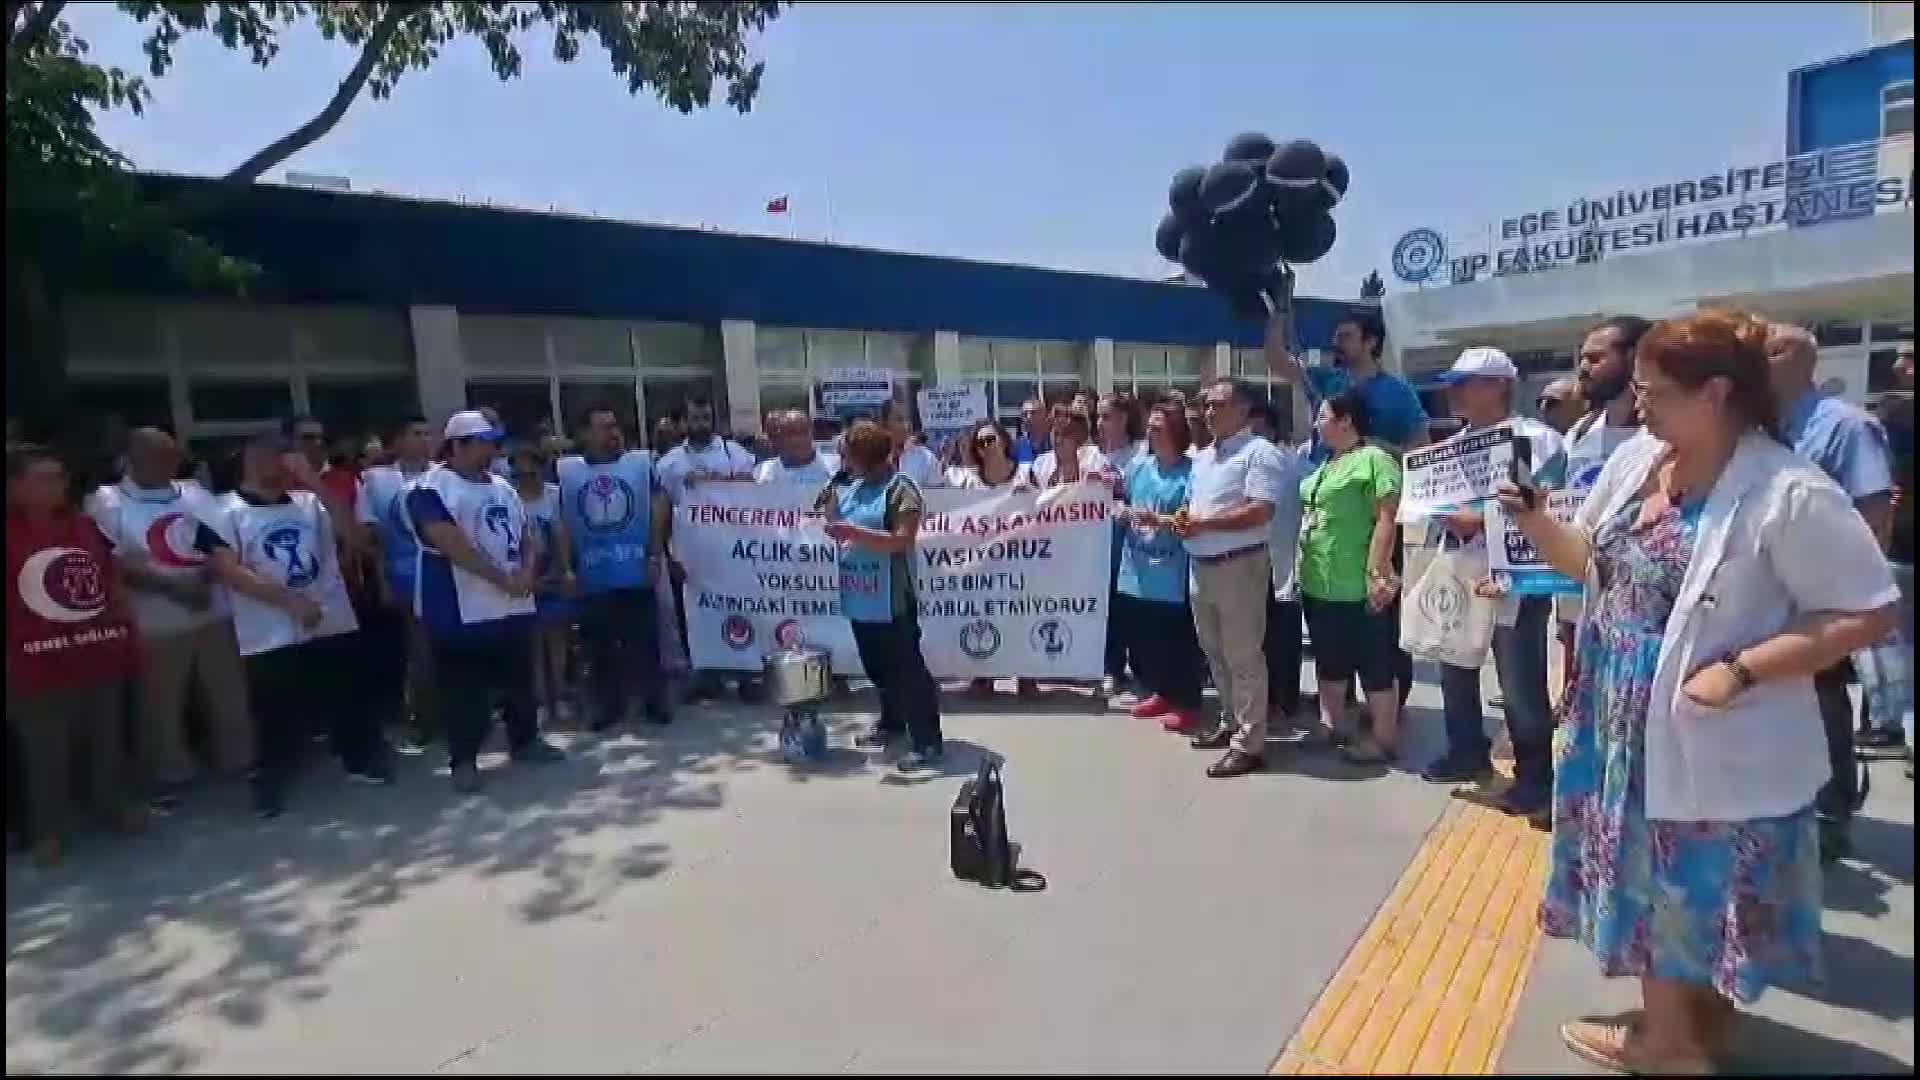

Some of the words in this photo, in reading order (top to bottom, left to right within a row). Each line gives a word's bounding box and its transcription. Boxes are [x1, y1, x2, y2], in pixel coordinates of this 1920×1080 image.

[1501, 209, 1560, 241] EGE
[962, 514, 989, 538] AŞ
[732, 538, 792, 565] AÇLIK
[757, 572, 840, 591] YOKSULL
[790, 600, 840, 616] TEME
[919, 599, 980, 616] KABUL
[984, 597, 1098, 616] ETMİYORUZ
